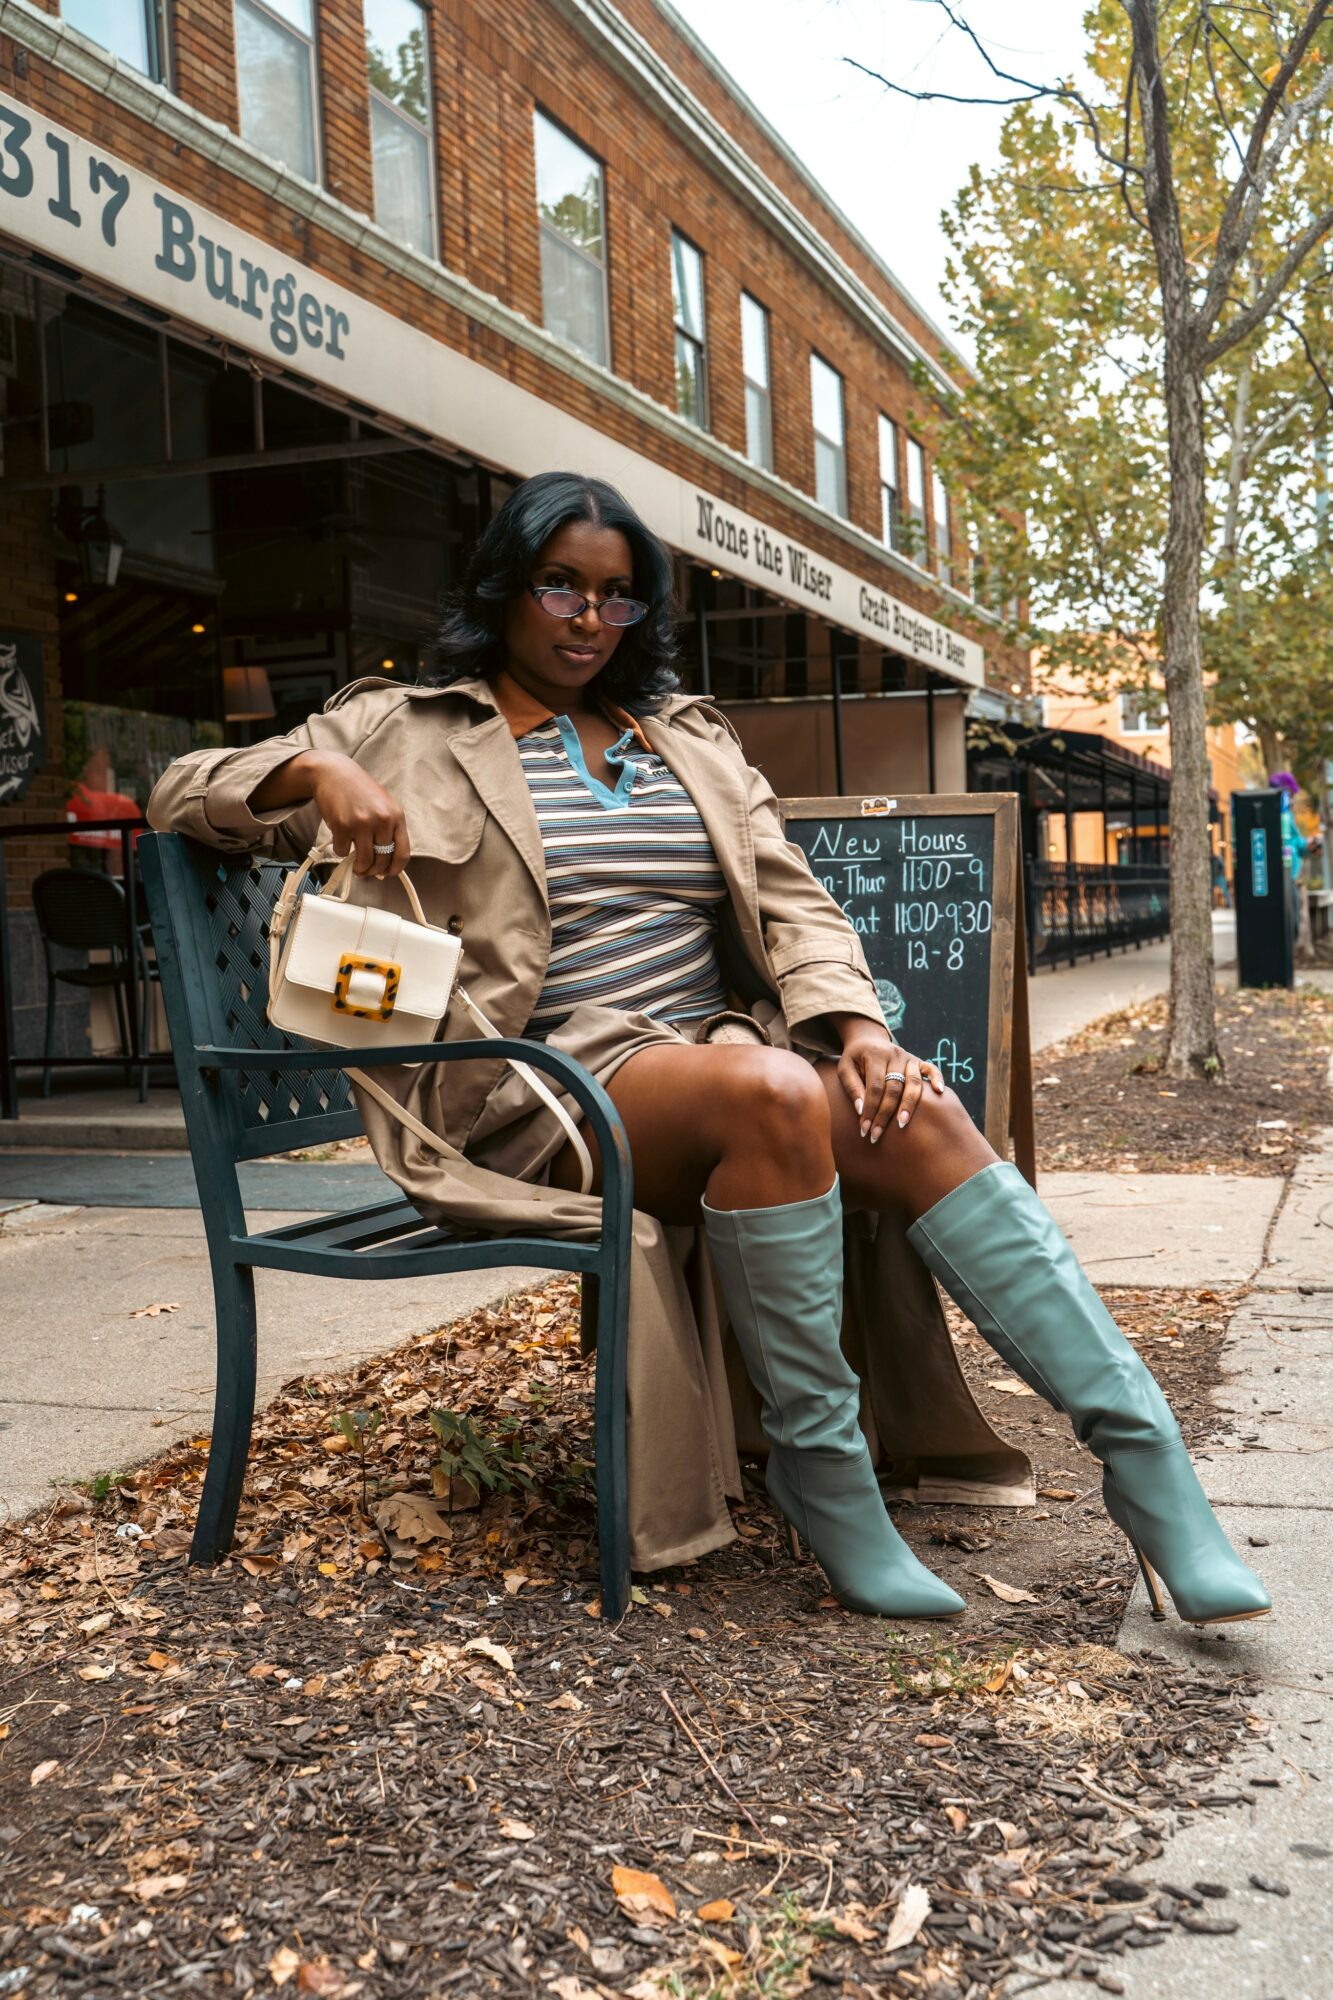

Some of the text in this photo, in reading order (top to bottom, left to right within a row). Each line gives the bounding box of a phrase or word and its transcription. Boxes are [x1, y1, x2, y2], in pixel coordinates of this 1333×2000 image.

[0, 105, 350, 361] 317 Burger
[696, 494, 833, 602] None the Wiser
[860, 585, 889, 631] Craft
[893, 604, 933, 654] Burgers
[945, 632, 966, 668] Beer
[0, 725, 16, 749] et
[810, 820, 967, 856] New Hours
[926, 1038, 975, 1083] fts
